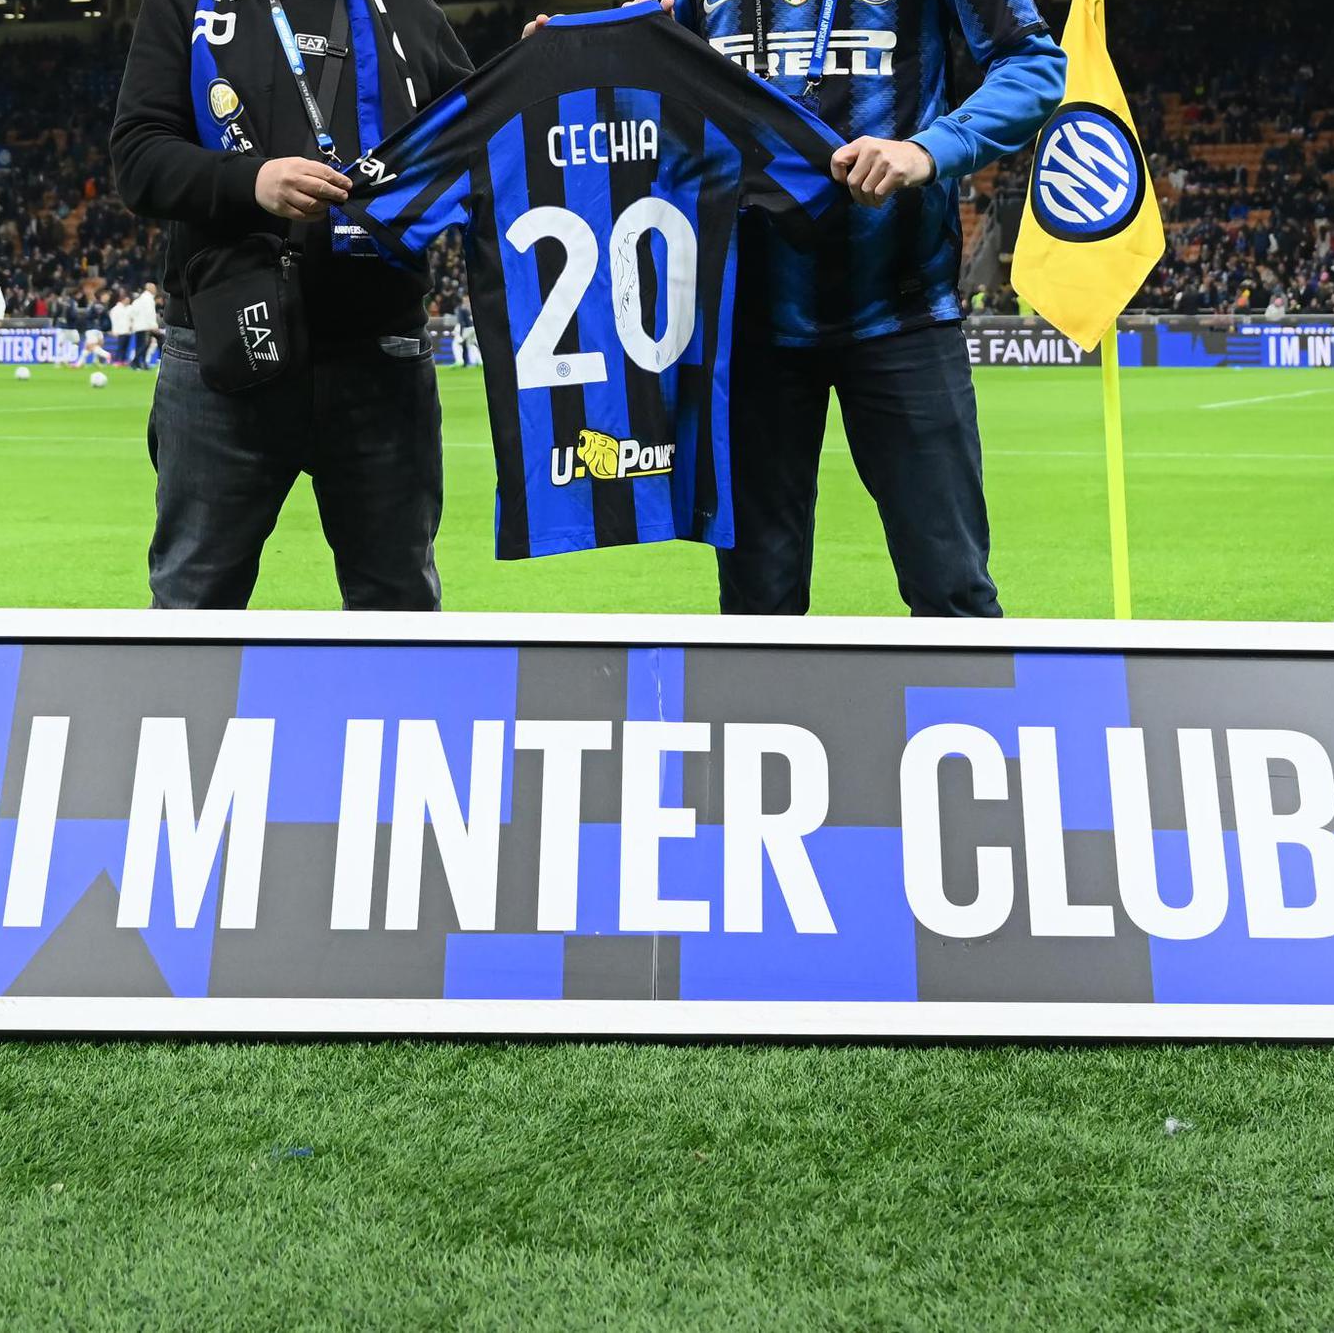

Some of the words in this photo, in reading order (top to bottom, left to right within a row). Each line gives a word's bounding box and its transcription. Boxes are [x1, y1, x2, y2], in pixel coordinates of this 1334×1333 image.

[756, 17, 764, 53] EXPERIENCE
[813, 20, 830, 60] ANNIVERSARY
[547, 119, 659, 168] CECHIA
[505, 196, 698, 390] 20
[989, 338, 1086, 365] FAMILY
[1268, 337, 1277, 366] I
[1280, 337, 1302, 366] M
[2, 715, 71, 929] I
[115, 717, 277, 931] M
[327, 718, 840, 935] INTER
